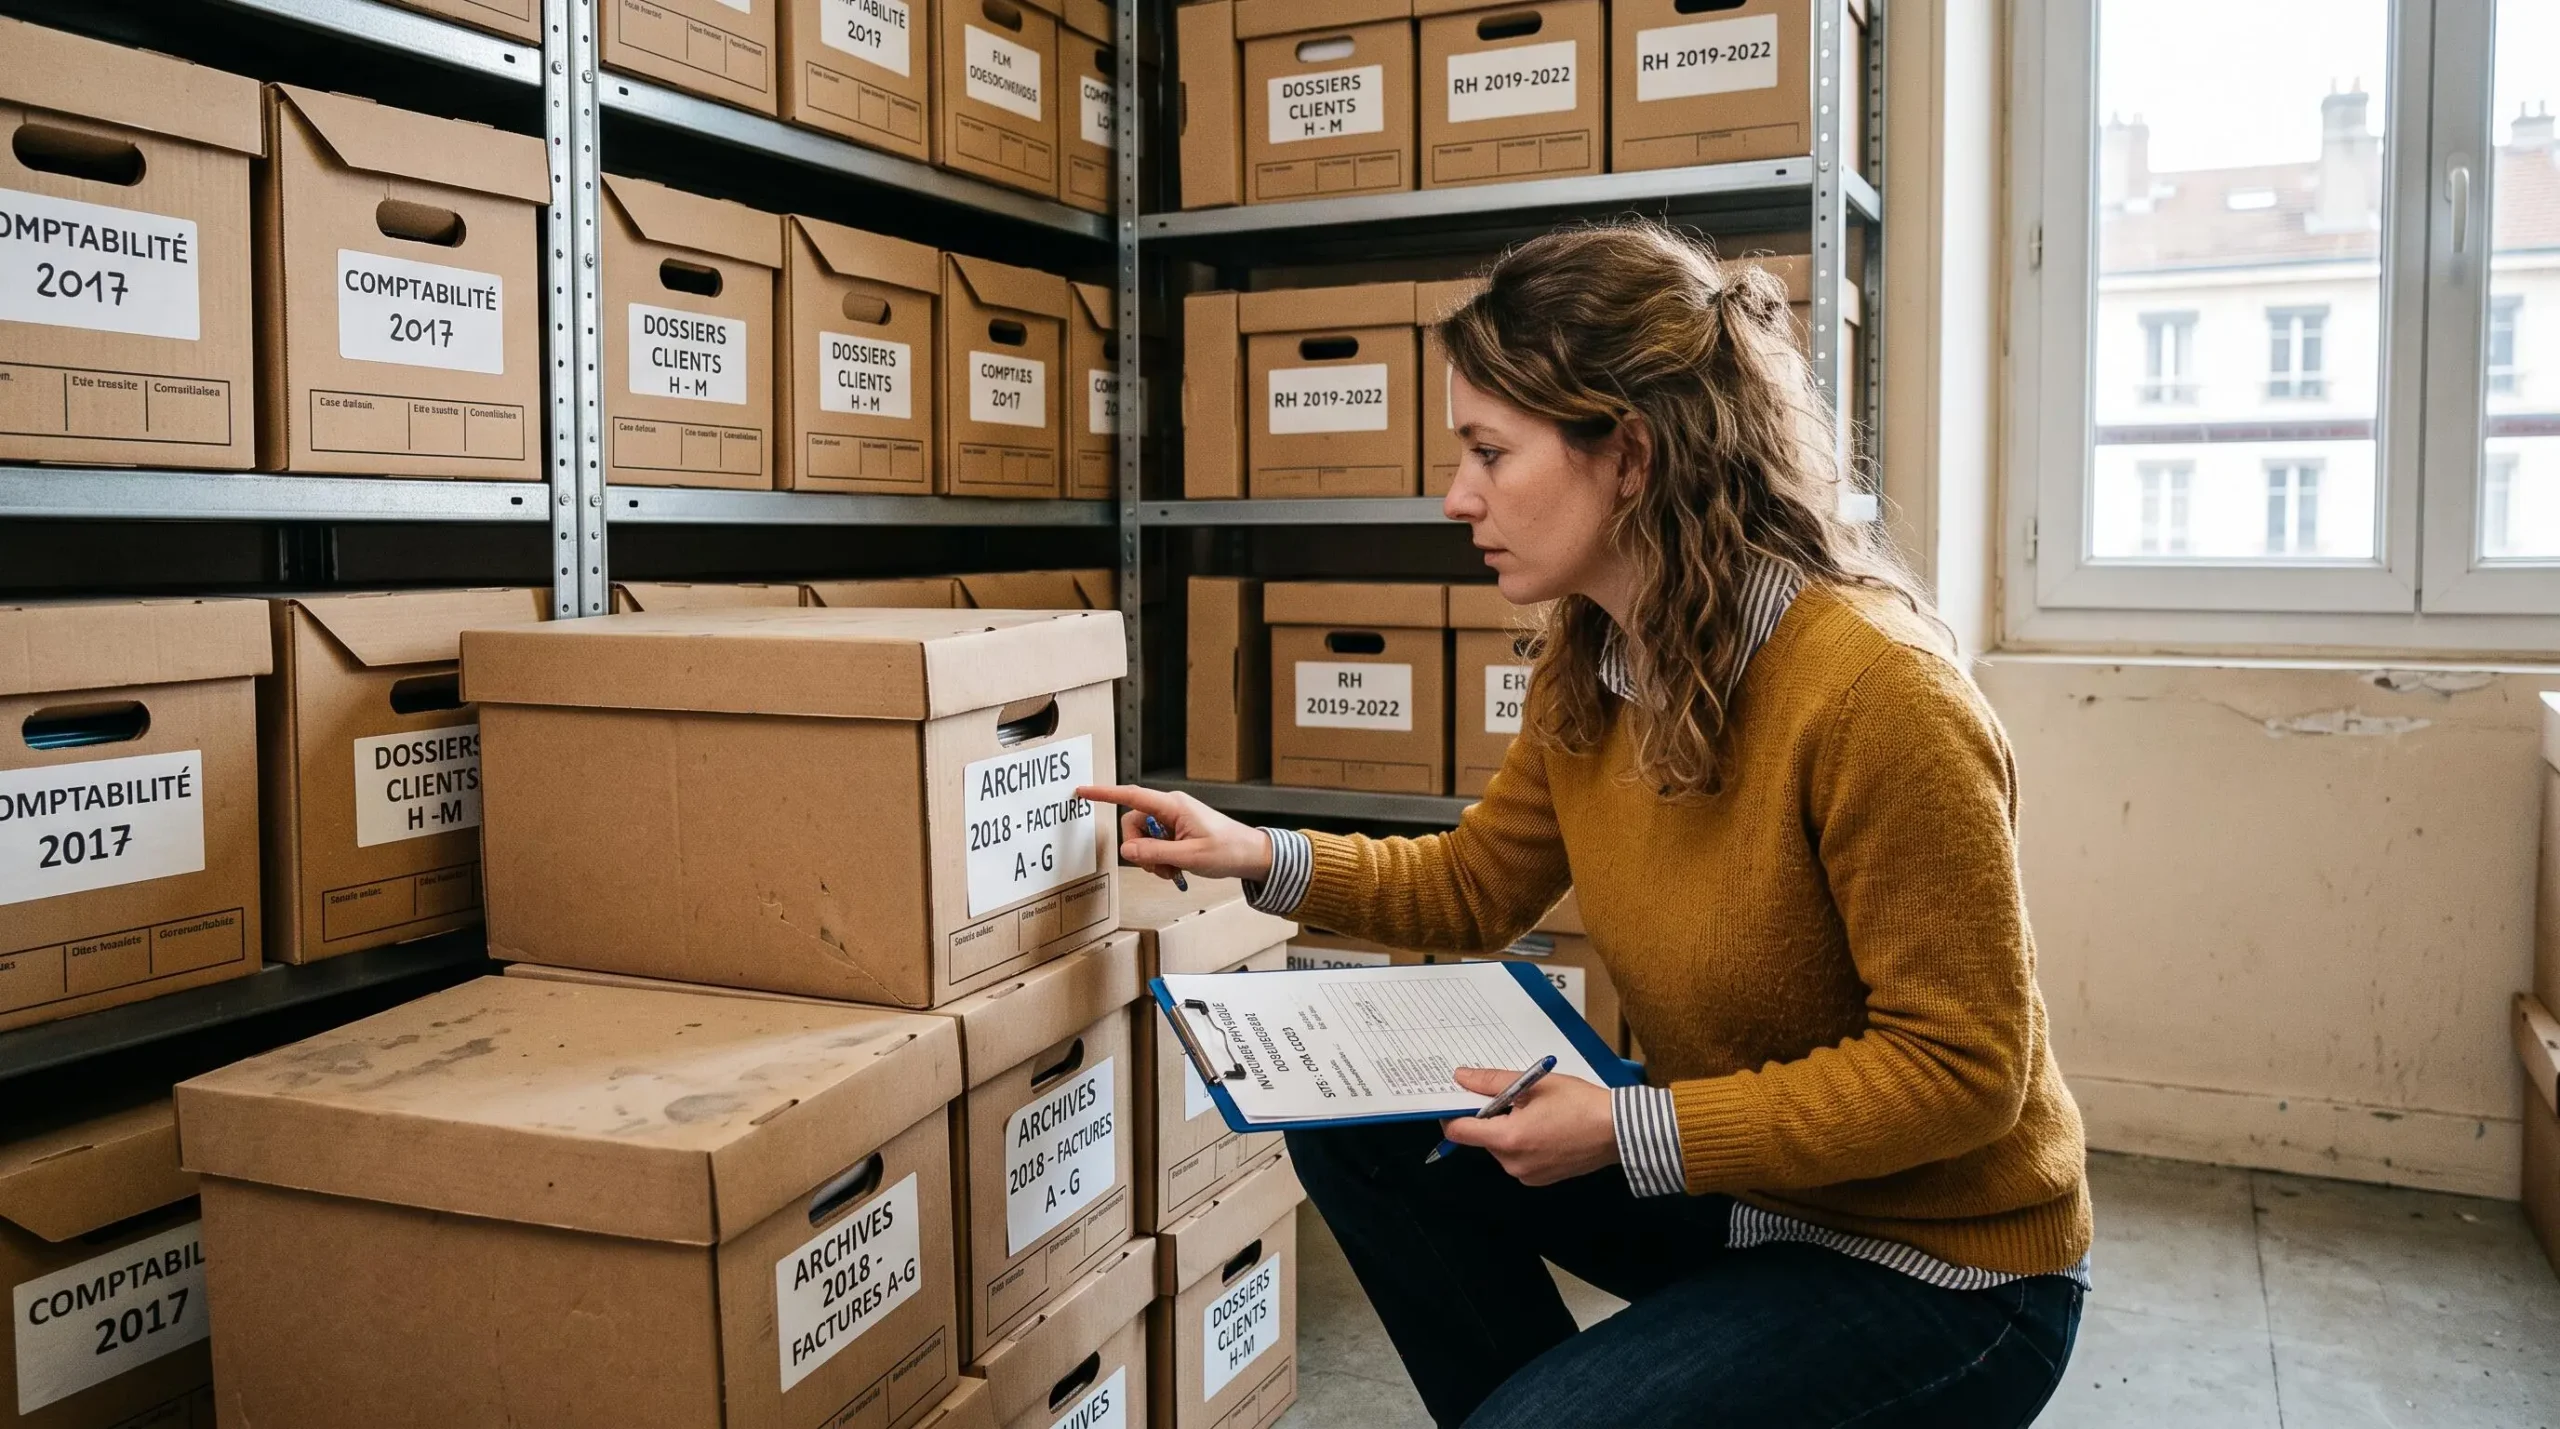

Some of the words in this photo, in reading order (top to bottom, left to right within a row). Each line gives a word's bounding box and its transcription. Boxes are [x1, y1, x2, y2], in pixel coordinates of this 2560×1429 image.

[848, 20, 881, 48] 2017
[1642, 53, 1669, 71] RH
[1676, 41, 1771, 68] 2019-2022
[1283, 74, 1361, 99] DOSSIERS
[1454, 77, 1478, 95] RH
[1485, 66, 1571, 91] 2019-2022
[1289, 98, 1356, 120] CLIENTS
[1304, 122, 1315, 136] H
[1330, 119, 1342, 134] M
[0, 211, 188, 264] OMPTABILITÉ
[36, 262, 129, 306] 2017
[345, 269, 497, 311] COMPTABILITÉ
[390, 313, 453, 348] 2017
[644, 314, 727, 345] DOSSIERS
[652, 347, 722, 374] CLIENTS
[832, 341, 896, 368] DOSSIERS
[669, 376, 680, 394] H
[695, 379, 707, 397] M
[838, 370, 892, 393] CLIENTS
[992, 389, 1021, 410] 2017
[1275, 392, 1297, 408] RH
[1303, 389, 1382, 407] 2019-2022
[851, 394, 860, 410] H
[870, 397, 880, 412] M
[1338, 672, 1362, 689] RH
[1307, 698, 1400, 717] 2019-2022
[1496, 701, 1523, 718] 20
[0, 766, 191, 822] OMPTABILITÉ
[387, 767, 479, 803] CLIENTS
[980, 751, 1071, 801] ARCHIVES
[408, 806, 424, 830] H
[970, 814, 1011, 851] 2018
[1027, 797, 1092, 834] FACTURES
[39, 824, 132, 868] 2017
[1014, 852, 1027, 882] A
[1041, 843, 1054, 871] G
[1018, 1078, 1096, 1148] ARCHIVES
[1009, 1152, 1045, 1196] 2018
[1057, 1112, 1112, 1164] FACTURES
[1044, 1184, 1057, 1213] A
[1069, 1168, 1080, 1196] G
[793, 1200, 893, 1291] ARCHIVES
[29, 1241, 206, 1326] COMPTABIL
[822, 1253, 871, 1308] 2018
[1213, 1268, 1270, 1328] DOSSIERS
[95, 1287, 189, 1356] 2017
[792, 1282, 882, 1366] FACTURES
[887, 1257, 916, 1299] A-G
[1218, 1299, 1266, 1351] CLIENTS
[1230, 1334, 1254, 1370] H-M
